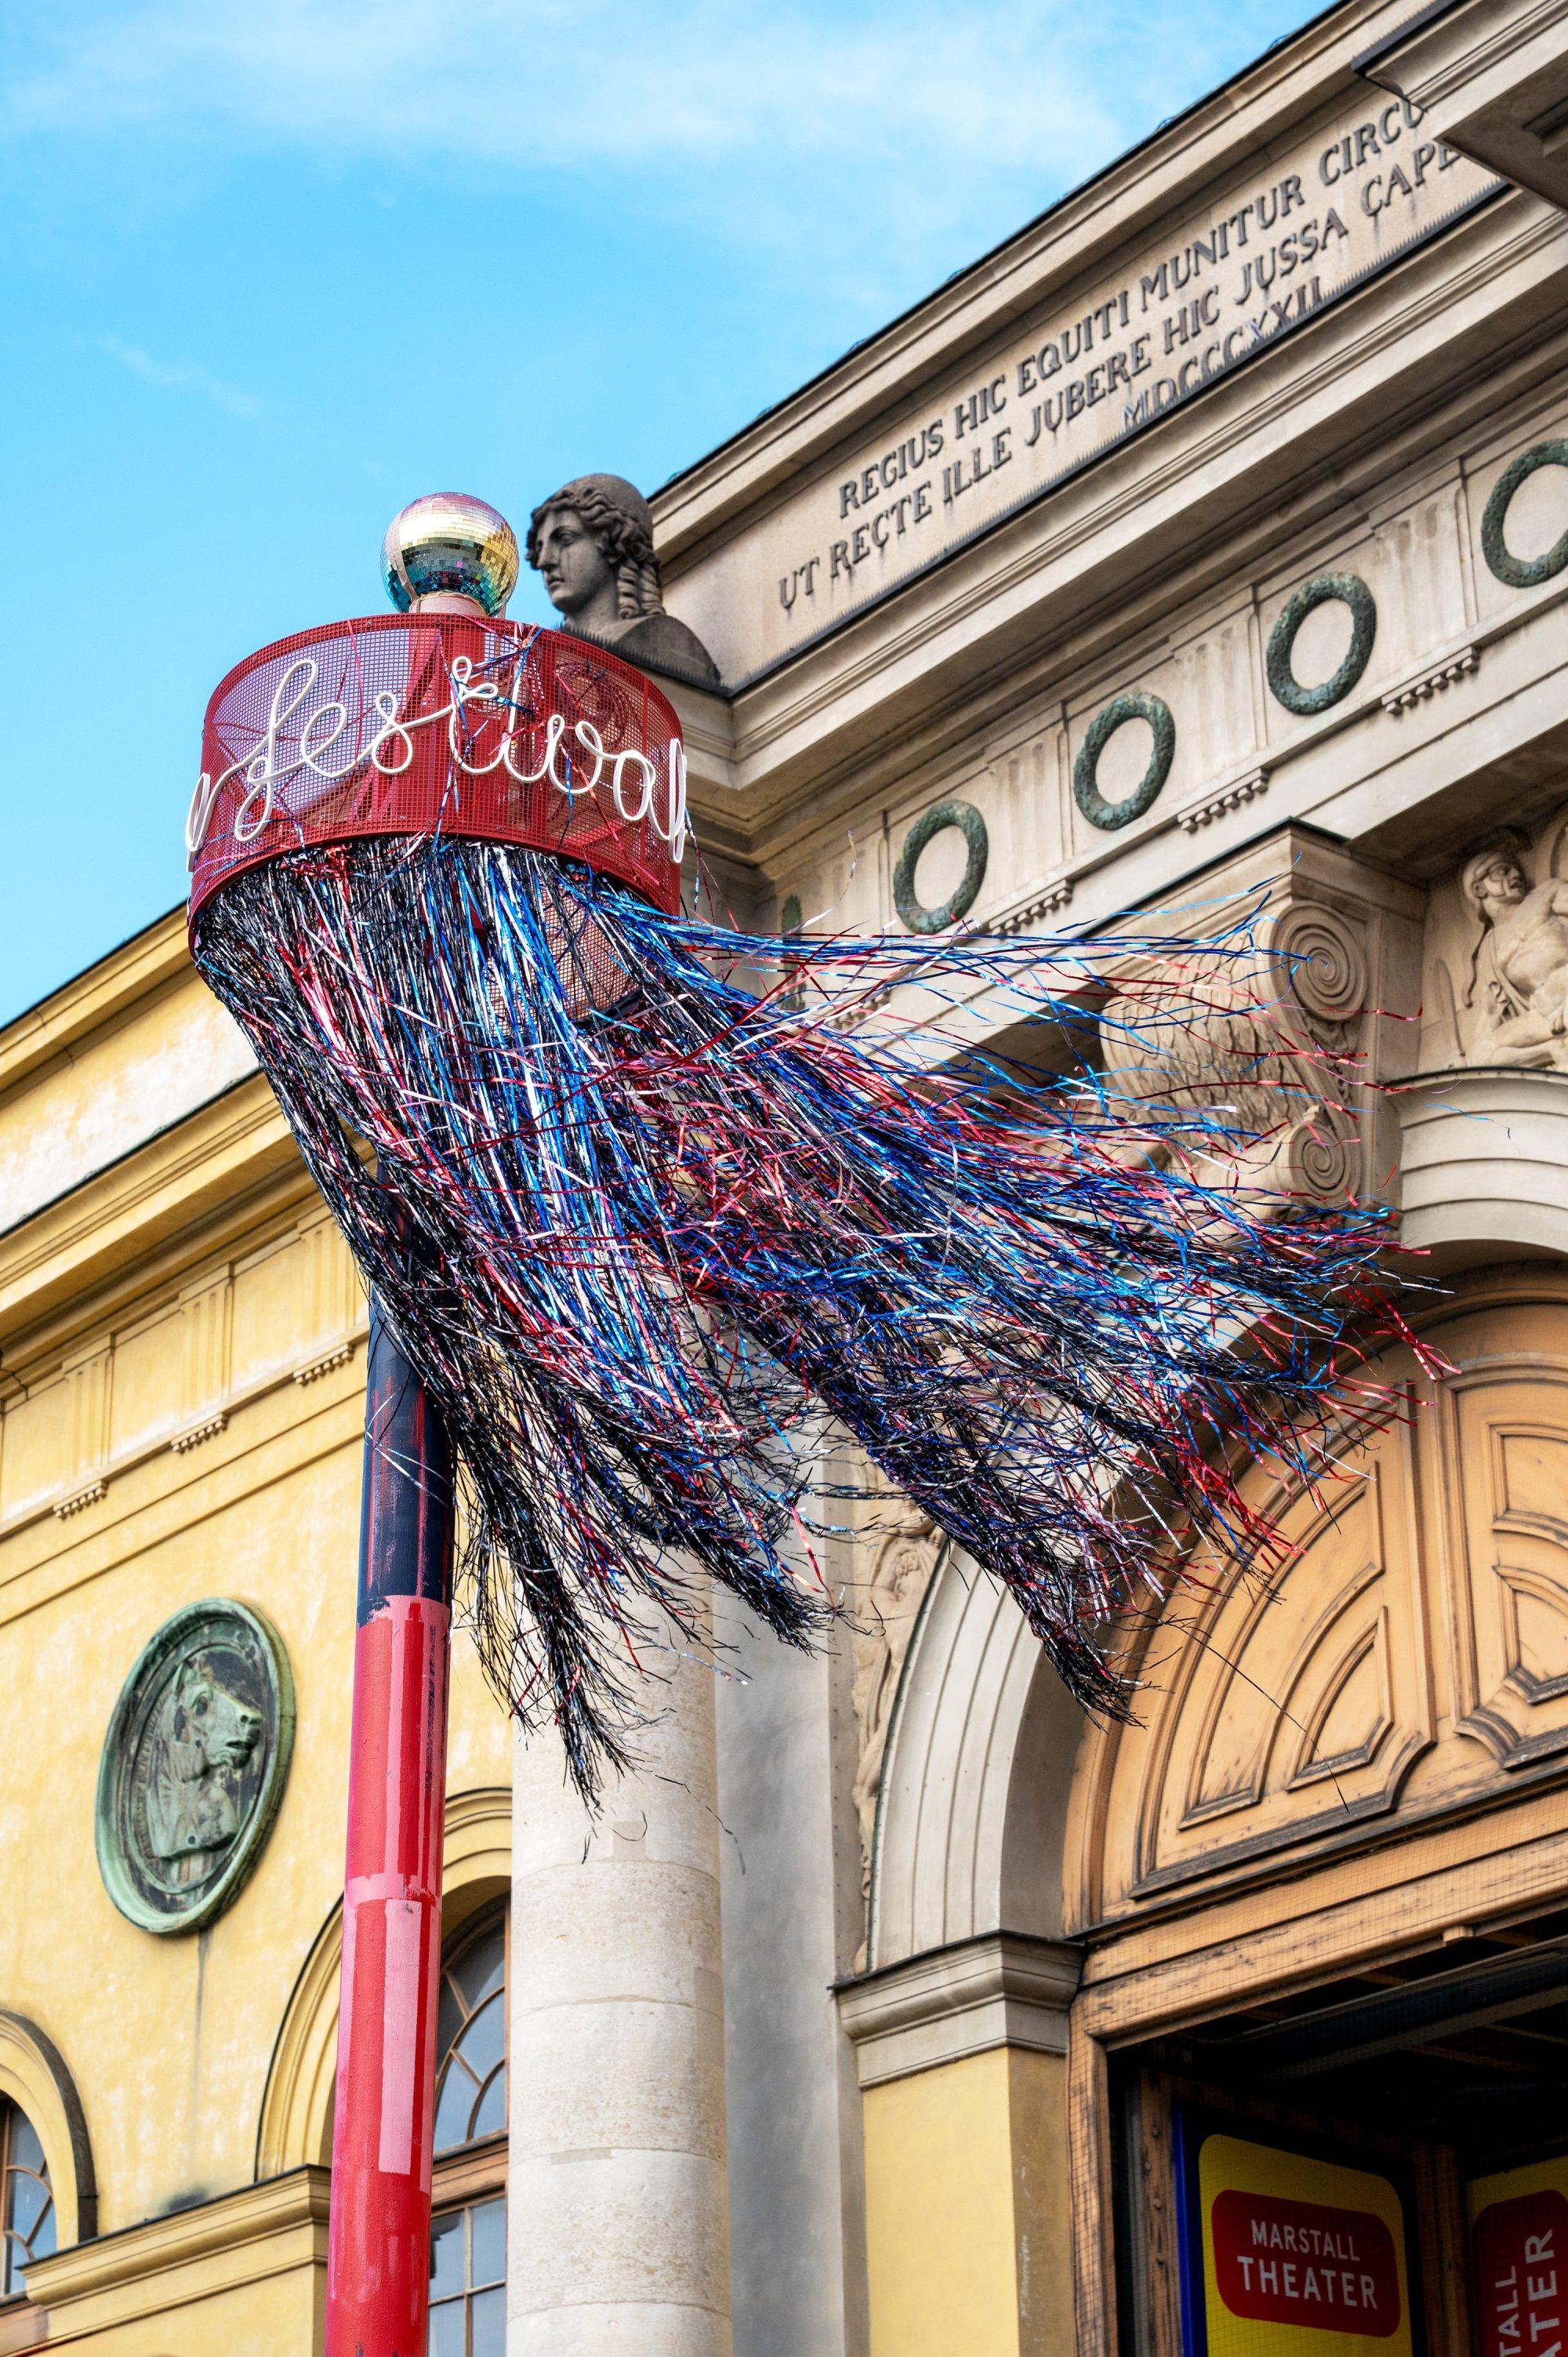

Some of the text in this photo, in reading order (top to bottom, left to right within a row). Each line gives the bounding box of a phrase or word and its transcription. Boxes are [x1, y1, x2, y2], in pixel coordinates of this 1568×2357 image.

[779, 557, 820, 610] UT
[829, 481, 932, 579] RECTE
[942, 427, 1012, 503] ILLE
[1024, 333, 1152, 446] JUBERE
[1163, 285, 1221, 355] HIC
[1234, 208, 1348, 304] JUSSA
[838, 419, 945, 519] REGIUS
[953, 375, 1007, 439] HIC
[1016, 290, 1129, 397] EQUITI
[1139, 174, 1305, 312] MUNITUR
[1121, 276, 1323, 433] MDCCCXXII
[1236, 2254, 1380, 2310] THEATER
[1250, 2219, 1361, 2262] MARSTALL
